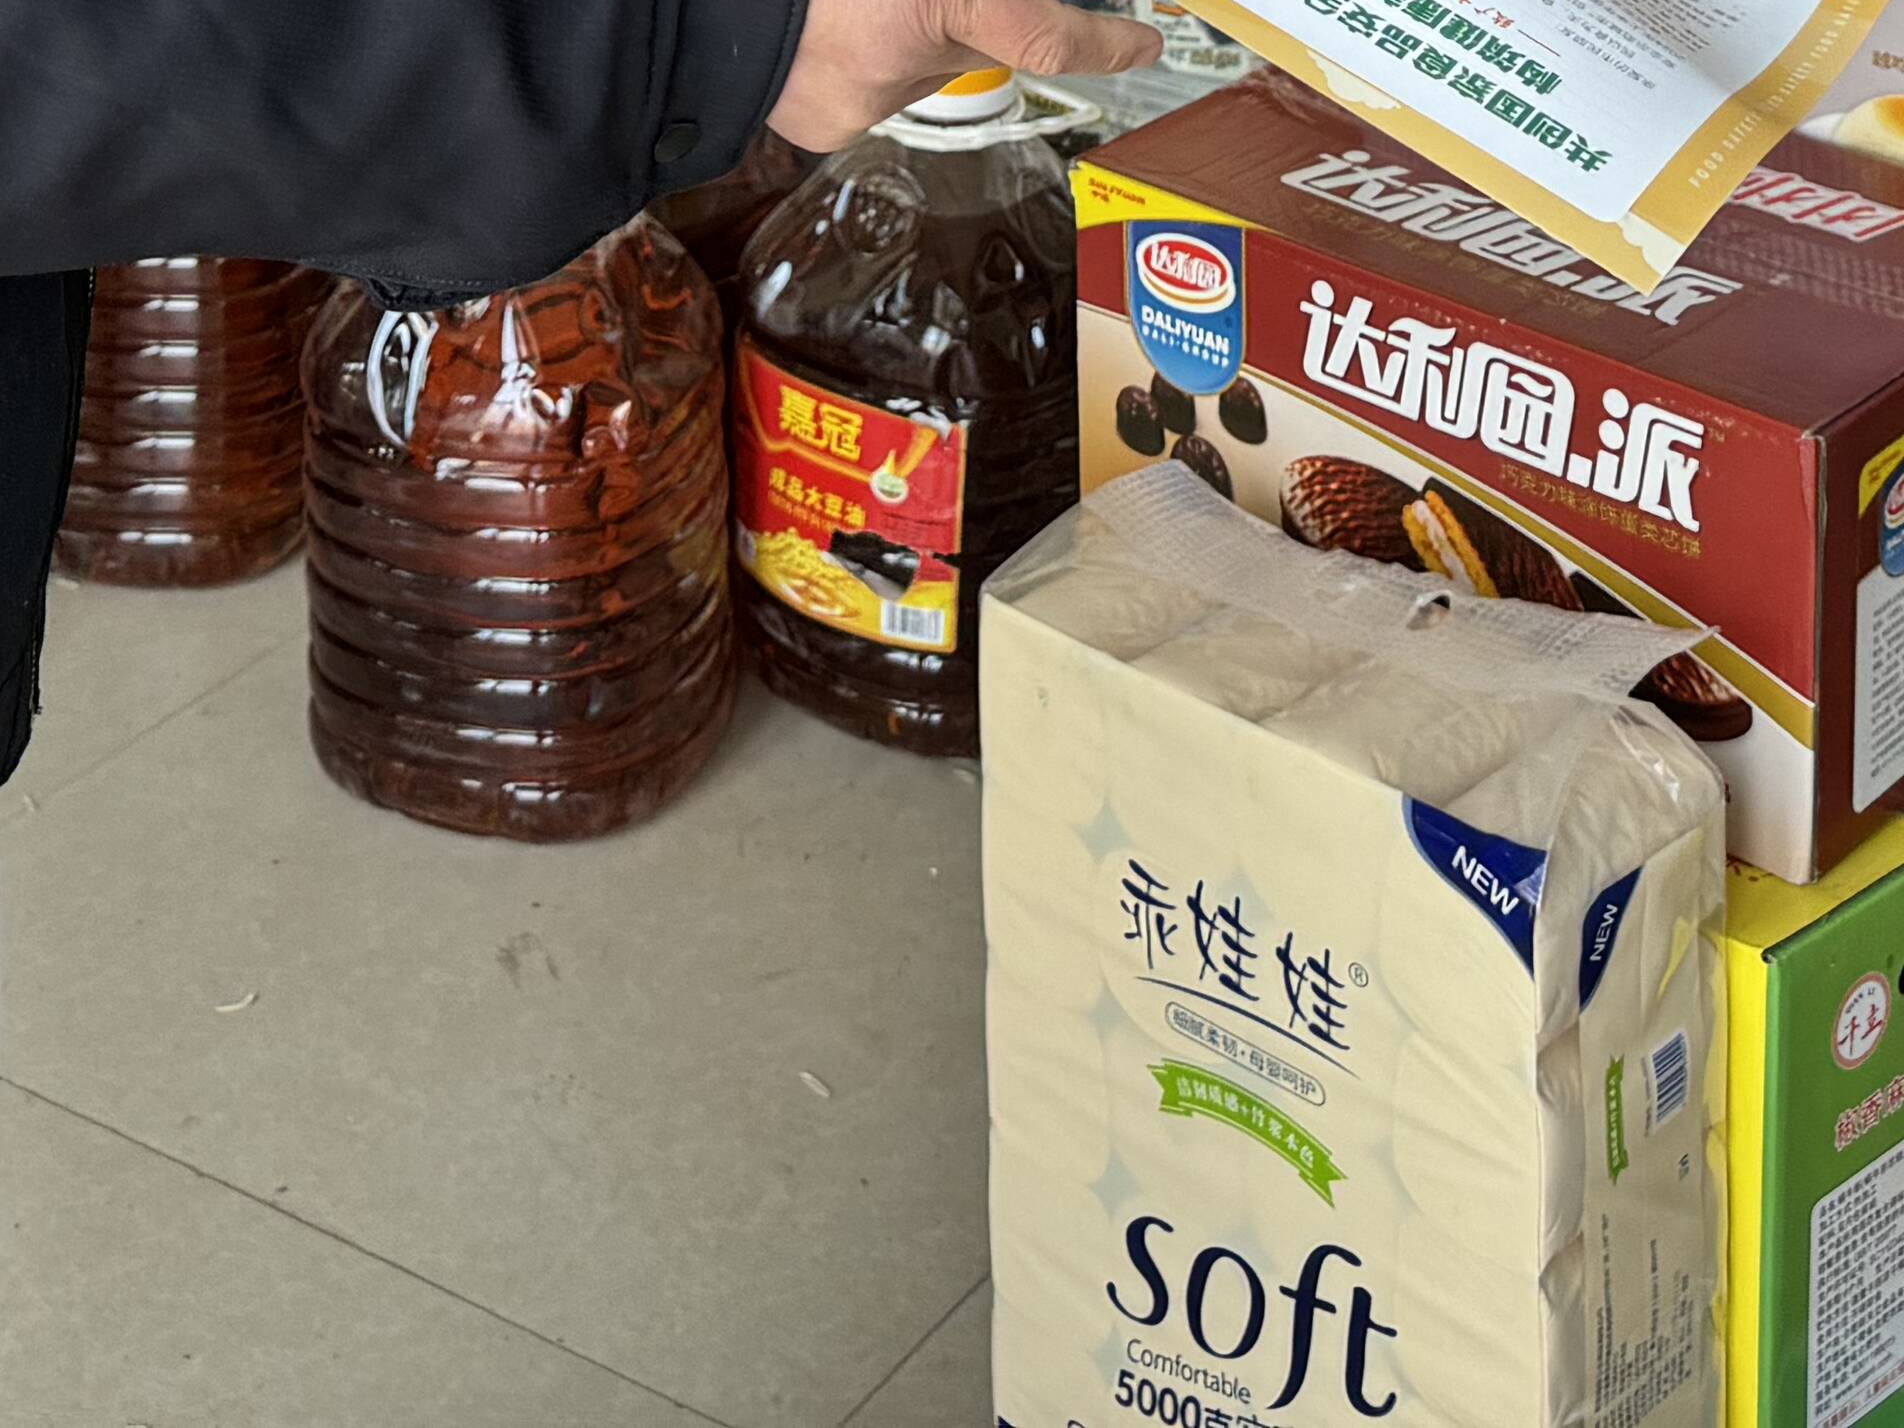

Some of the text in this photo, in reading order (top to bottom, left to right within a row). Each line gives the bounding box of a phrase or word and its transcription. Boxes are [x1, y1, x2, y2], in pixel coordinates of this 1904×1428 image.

[1688, 150, 1725, 188] FOOD
[1148, 240, 1228, 292] 达利园
[1141, 303, 1230, 356] DALIYUAN
[778, 385, 864, 464] 嘉冠
[1451, 846, 1519, 917] NEW
[1589, 902, 1617, 963] NEW
[1126, 1339, 1252, 1405] Comfortable
